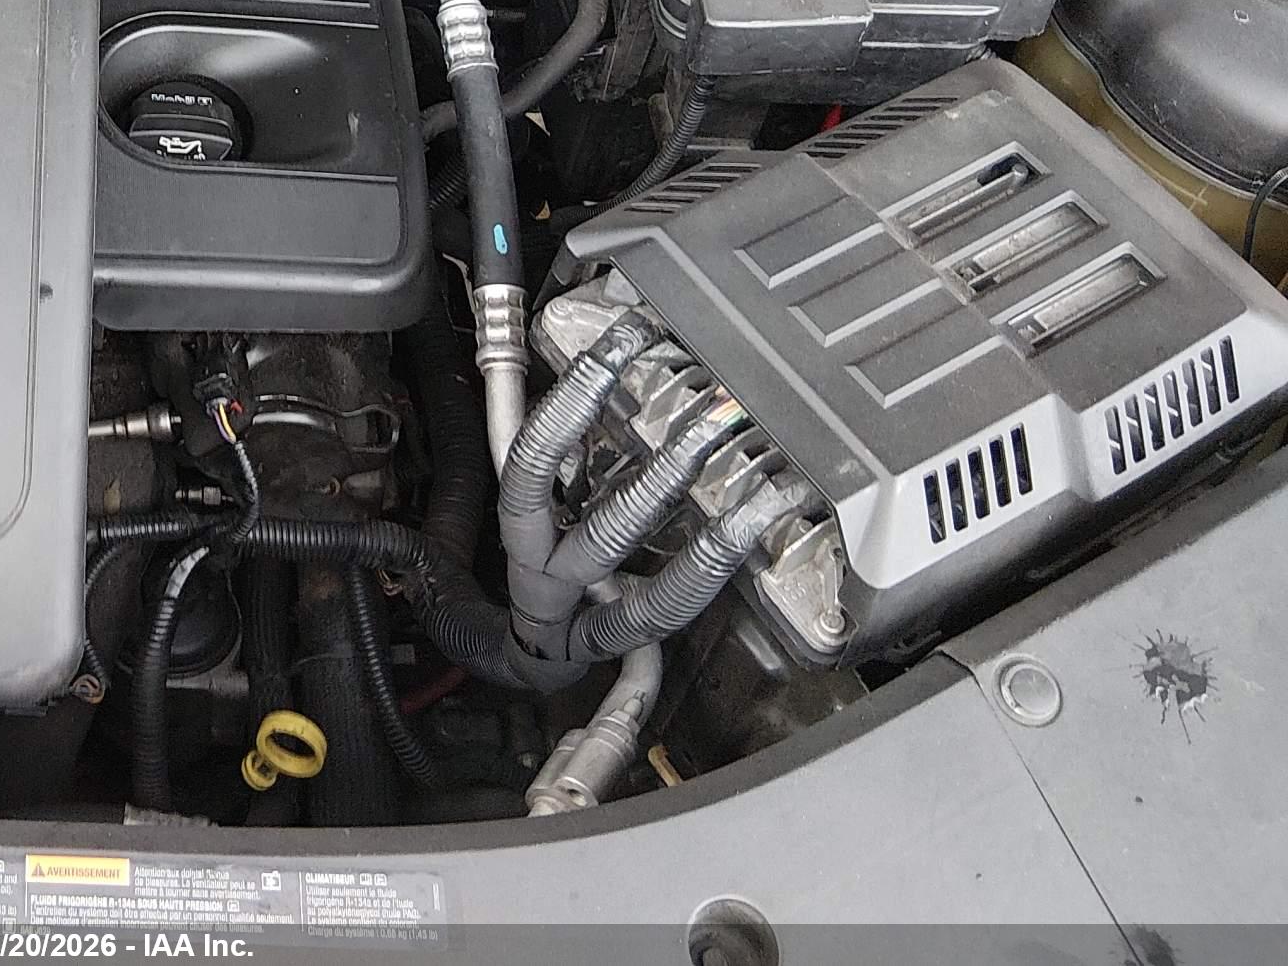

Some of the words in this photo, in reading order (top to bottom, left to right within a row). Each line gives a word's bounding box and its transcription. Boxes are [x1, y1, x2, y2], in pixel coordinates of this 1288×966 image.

[47, 866, 120, 879] AVERTISSEMENT
[305, 872, 355, 885] CLIMATISEUR
[31, 894, 57, 906] FLUIDE
[185, 900, 223, 912] PRESSION
